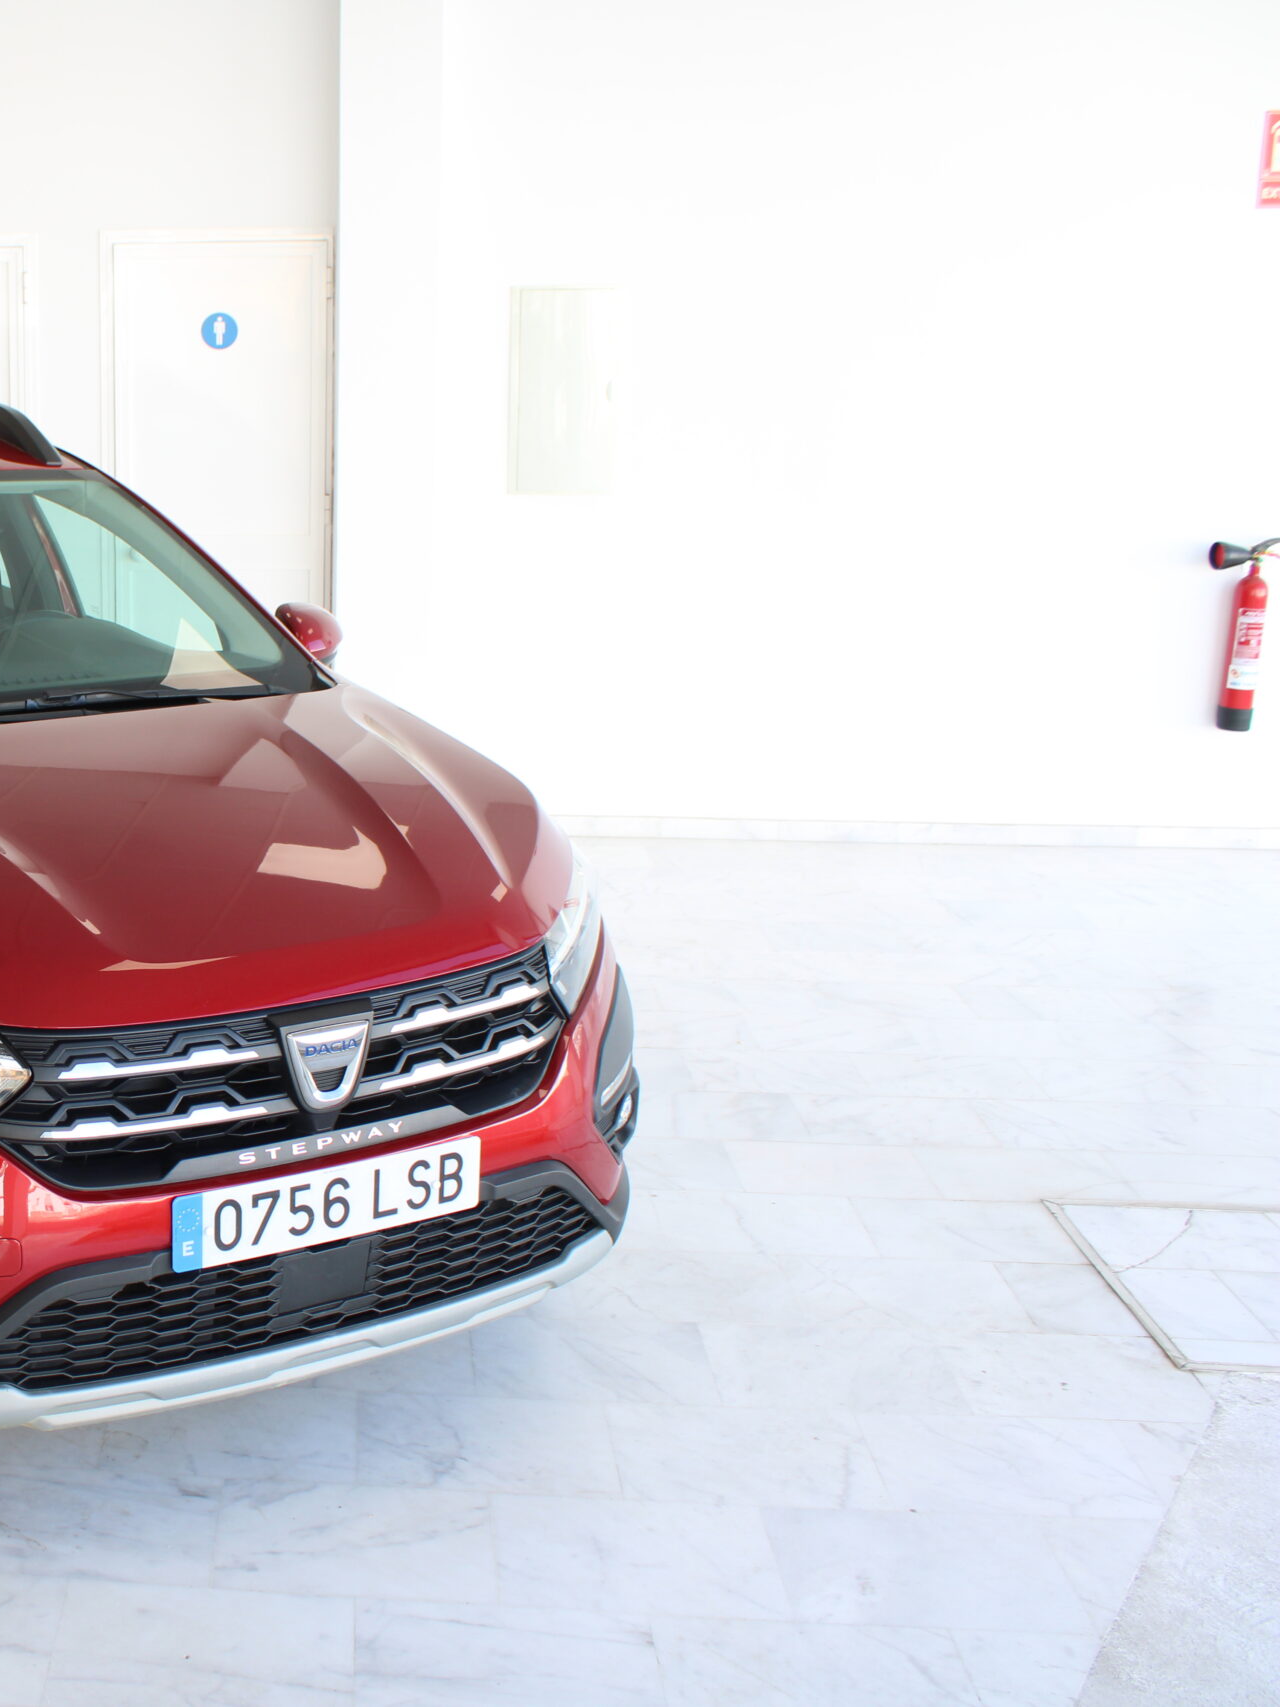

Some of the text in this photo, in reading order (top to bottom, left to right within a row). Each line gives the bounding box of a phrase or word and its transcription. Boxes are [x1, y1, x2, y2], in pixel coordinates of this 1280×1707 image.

[304, 1037, 359, 1058] DACIA
[237, 1120, 404, 1166] STEPWAY
[213, 1151, 464, 1252] 0756 LSB
[181, 1239, 195, 1258] E
